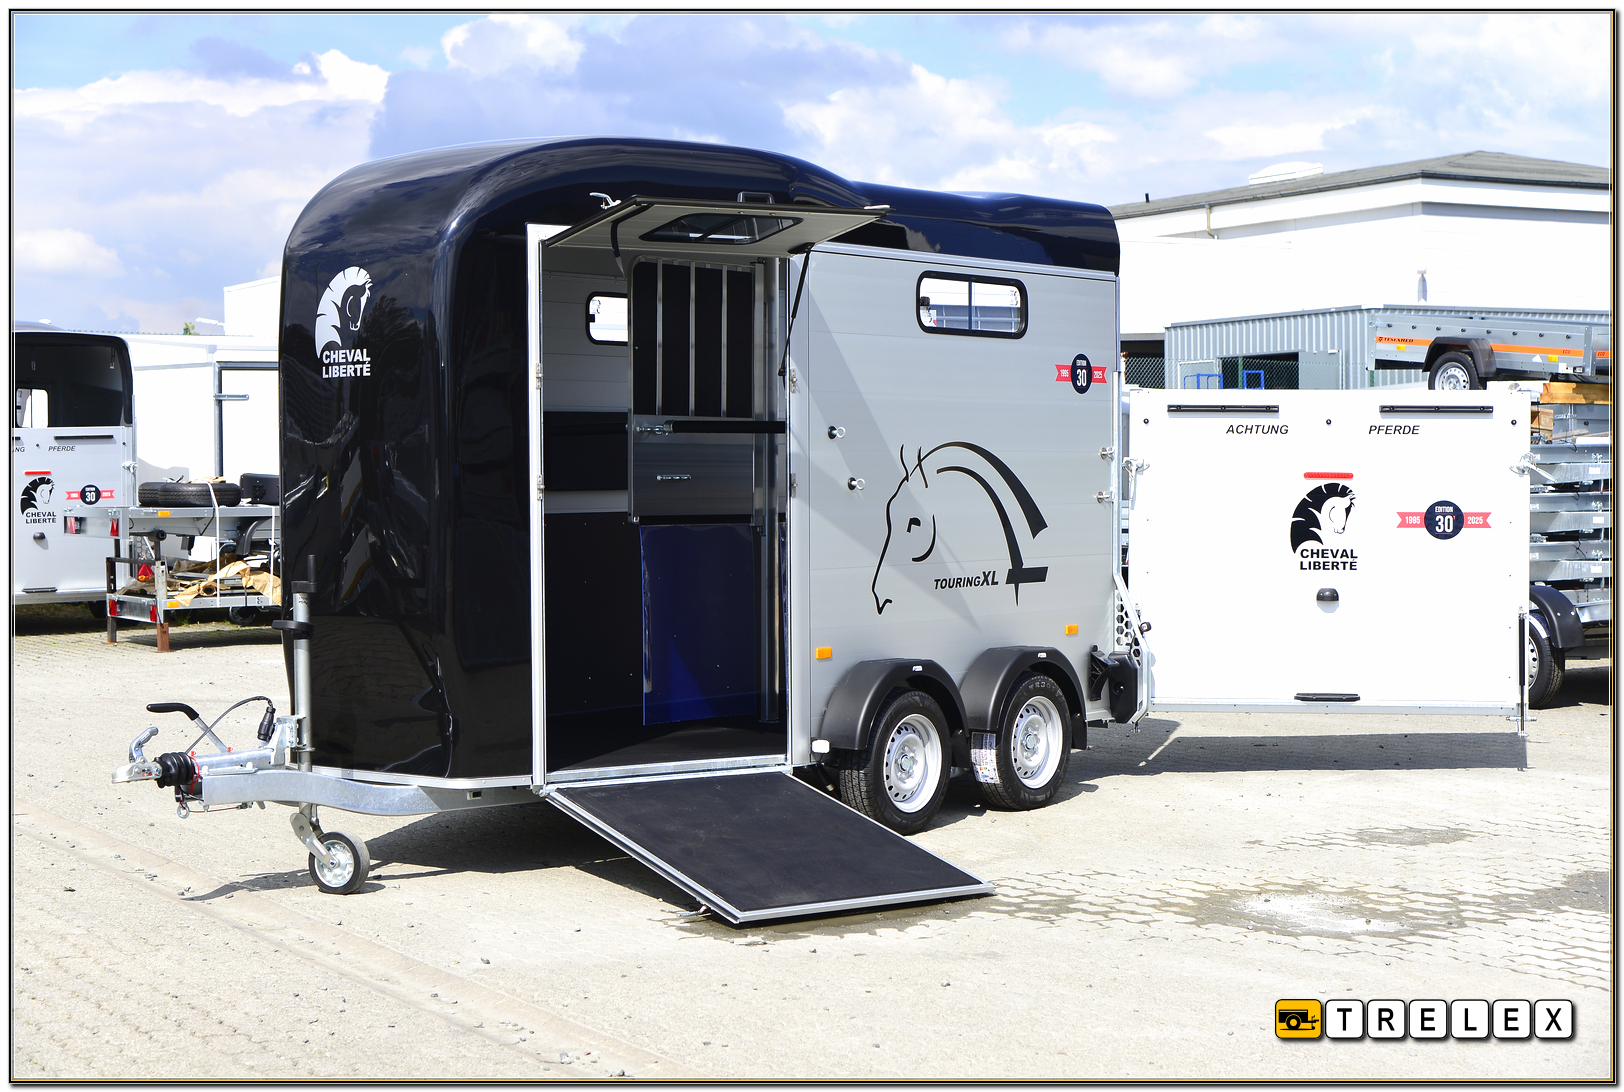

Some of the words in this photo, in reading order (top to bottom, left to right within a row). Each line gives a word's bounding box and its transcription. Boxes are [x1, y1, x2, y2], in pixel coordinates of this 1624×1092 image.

[322, 348, 371, 364] CHEVAL
[322, 361, 371, 379] LIBERTÉ
[1076, 369, 1086, 386] 30
[1226, 424, 1289, 435] ACHTUNG
[1368, 424, 1420, 435] PFERDE
[85, 492, 95, 501] 30
[1405, 515, 1421, 525] 1995
[1467, 516, 1484, 525] 2025
[1300, 548, 1359, 559] CHEVAL
[1300, 558, 1358, 571] LIBERTÉ
[933, 570, 999, 590] TOURINGXL
